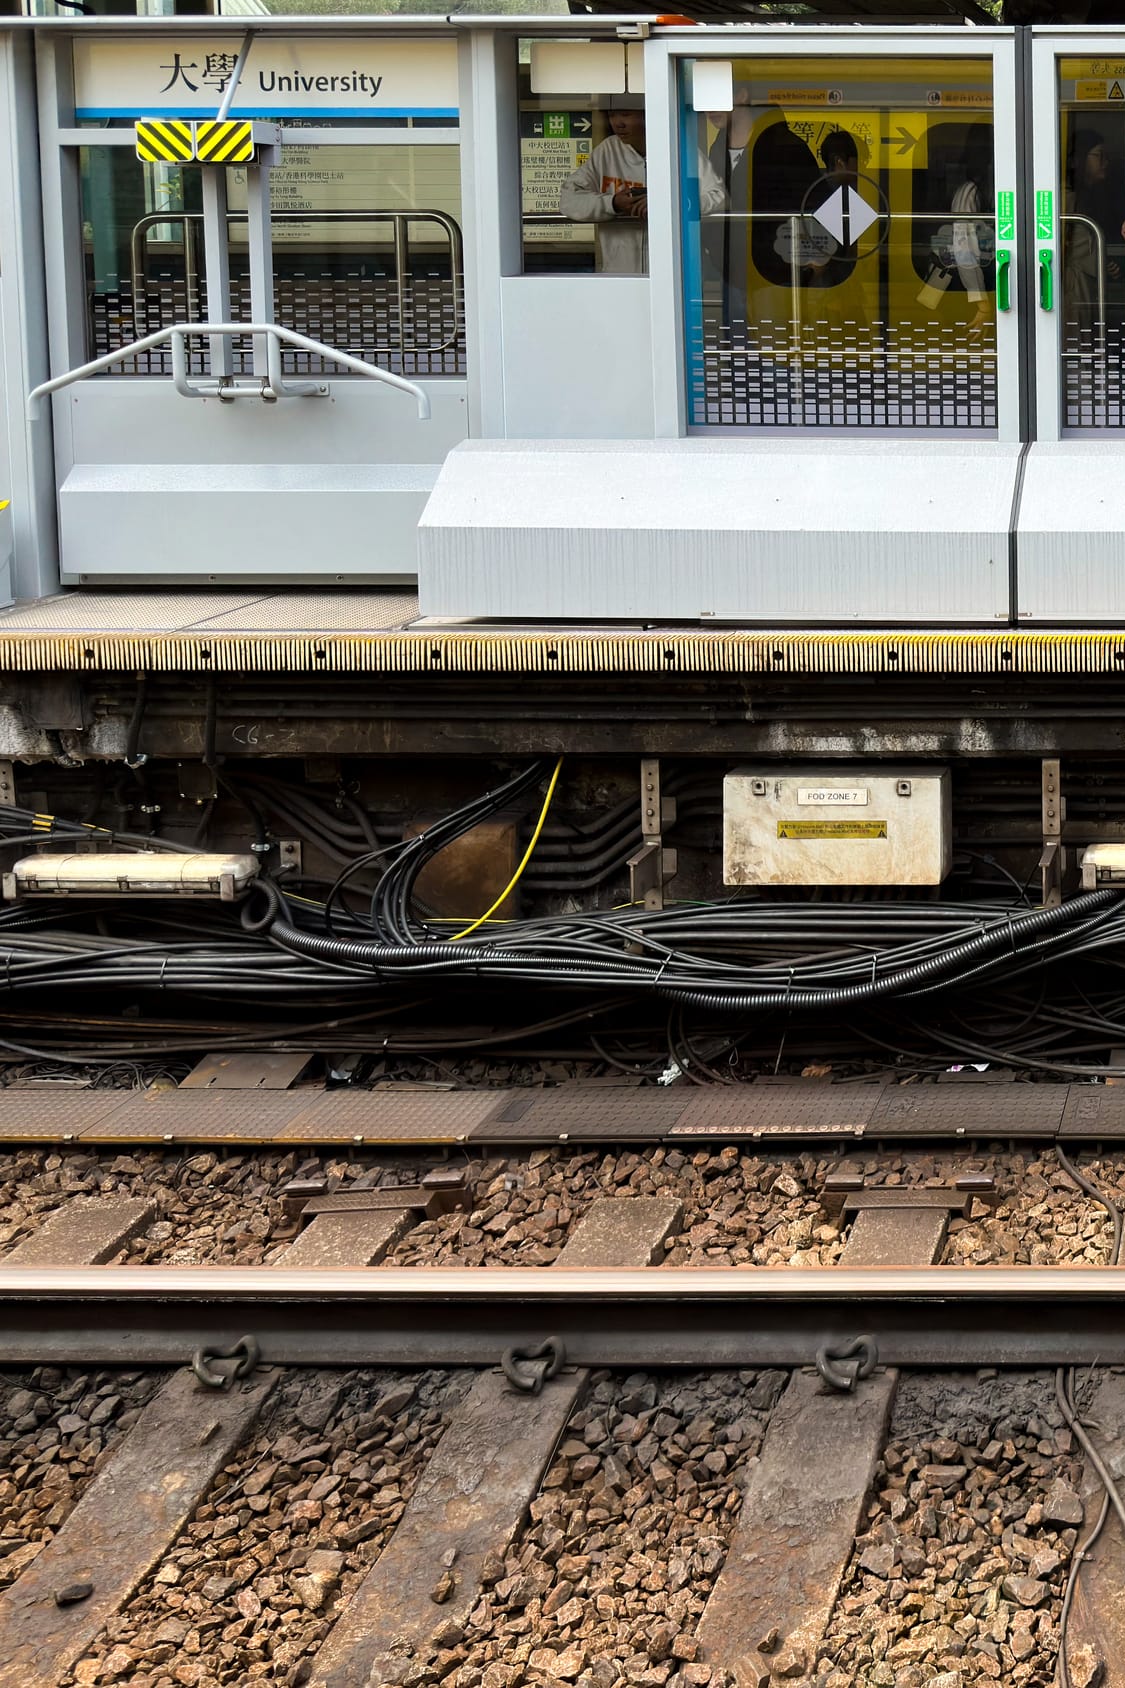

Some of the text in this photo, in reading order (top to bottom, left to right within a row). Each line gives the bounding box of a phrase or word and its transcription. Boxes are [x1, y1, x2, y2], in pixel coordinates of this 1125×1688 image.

[159, 53, 242, 93] 大學
[259, 70, 383, 97] University
[548, 115, 565, 129] 出
[579, 142, 587, 151] C
